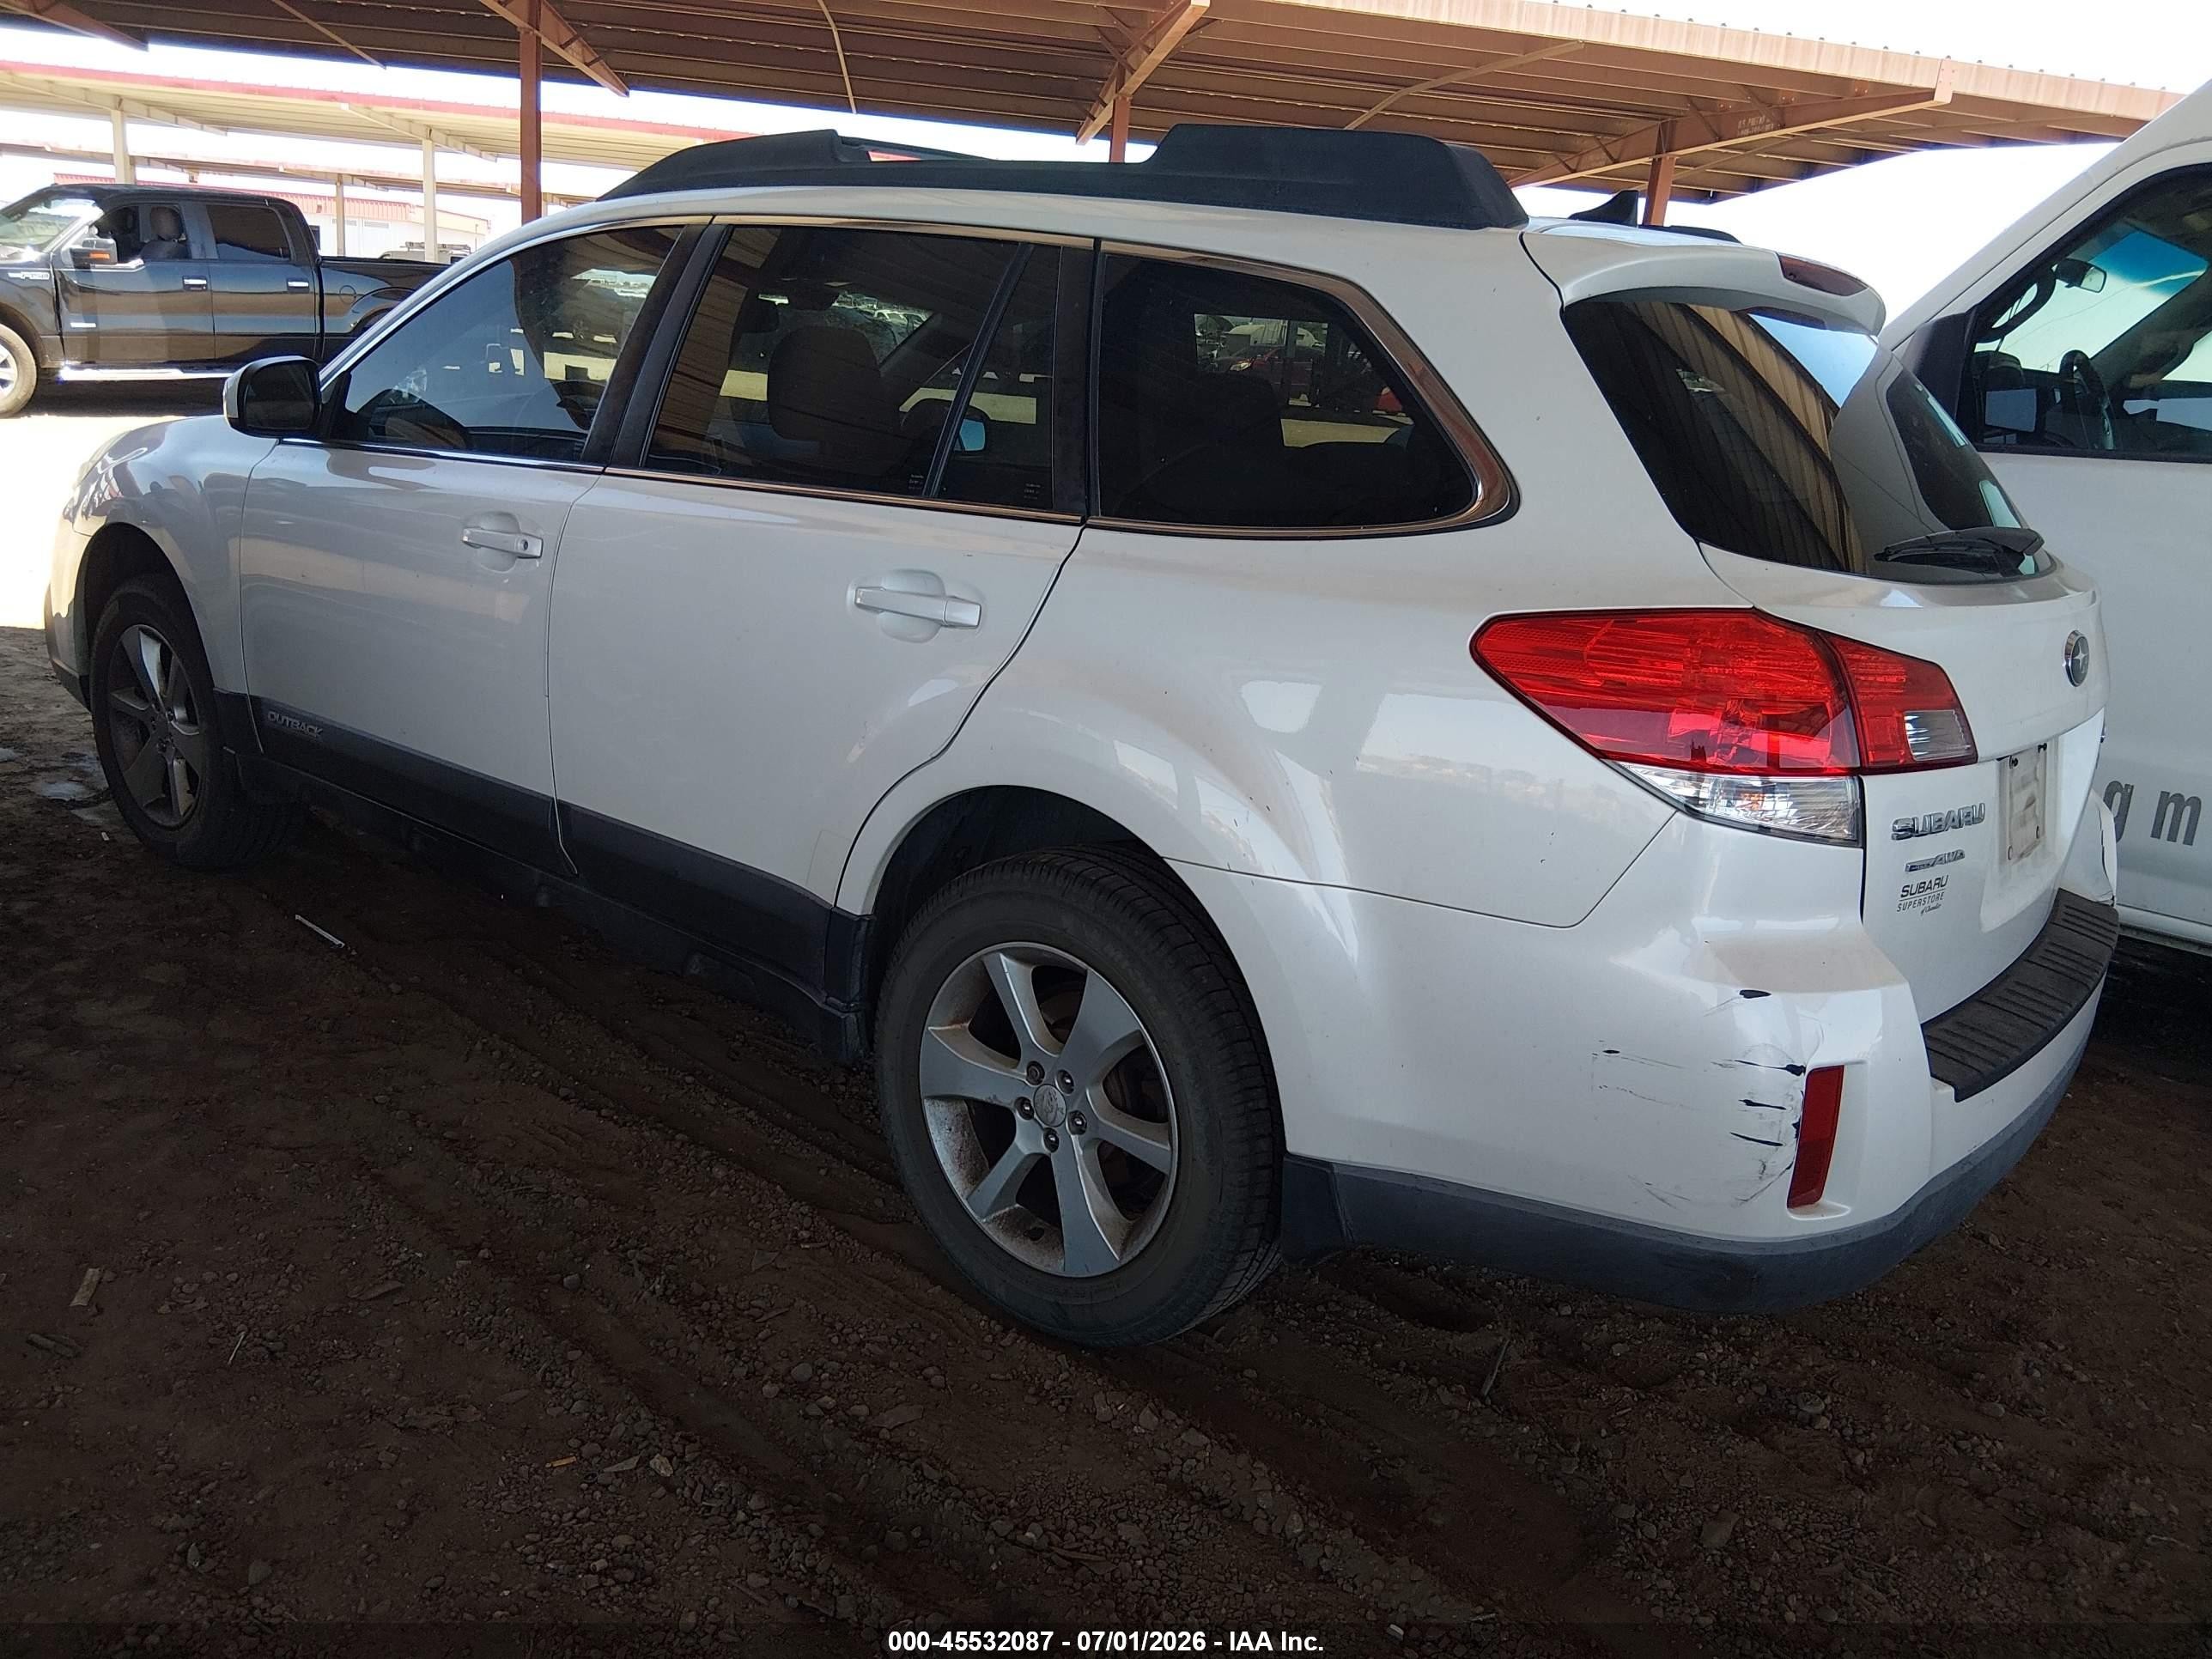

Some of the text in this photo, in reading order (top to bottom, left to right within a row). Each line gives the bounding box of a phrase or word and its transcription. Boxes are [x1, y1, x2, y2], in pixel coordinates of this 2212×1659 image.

[267, 711, 324, 736] OUTBACK
[1892, 803, 1985, 841] SUBARU
[1900, 875, 1949, 898] SUBARU
[1896, 892, 1945, 912] SUPERSTORE
